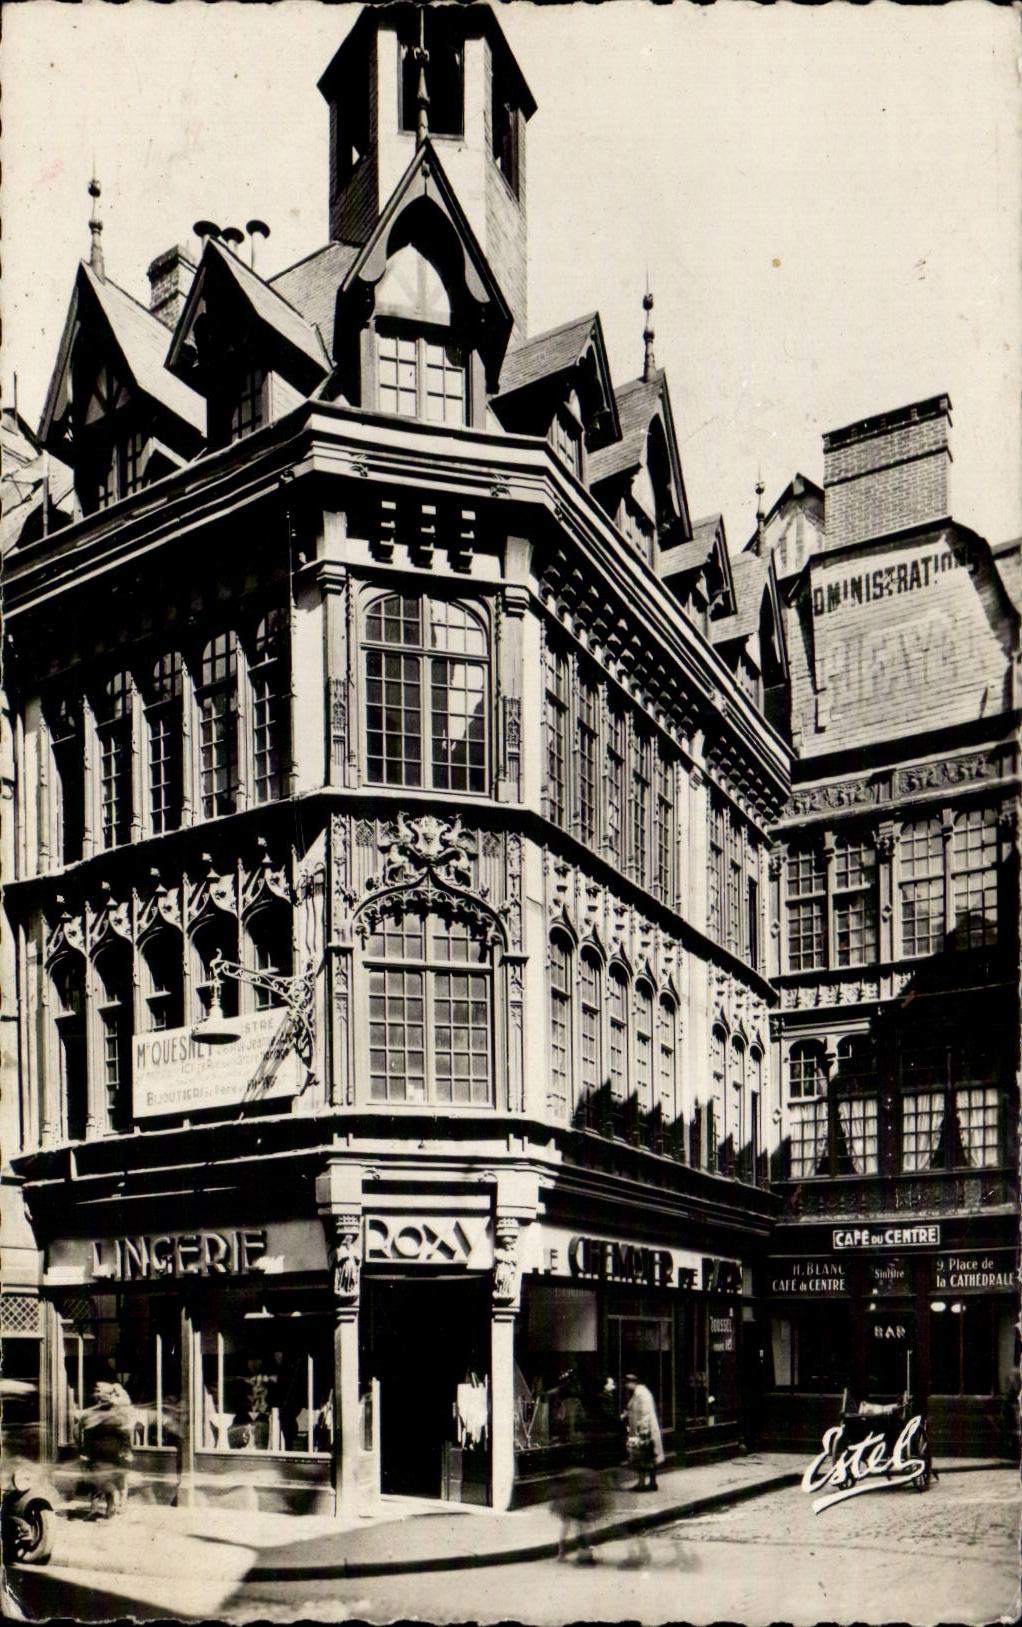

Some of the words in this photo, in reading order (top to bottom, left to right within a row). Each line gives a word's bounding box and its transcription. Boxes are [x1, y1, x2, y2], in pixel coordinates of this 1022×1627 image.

[367, 1217, 494, 1268] ROXY
[885, 1227, 937, 1244] CENTRE
[91, 1230, 266, 1281] LINGERIE
[949, 1257, 978, 1271] Place
[981, 1256, 994, 1270] de
[809, 1278, 845, 1291] CENTRE
[936, 1275, 946, 1288] la
[874, 1324, 906, 1339] BAR
